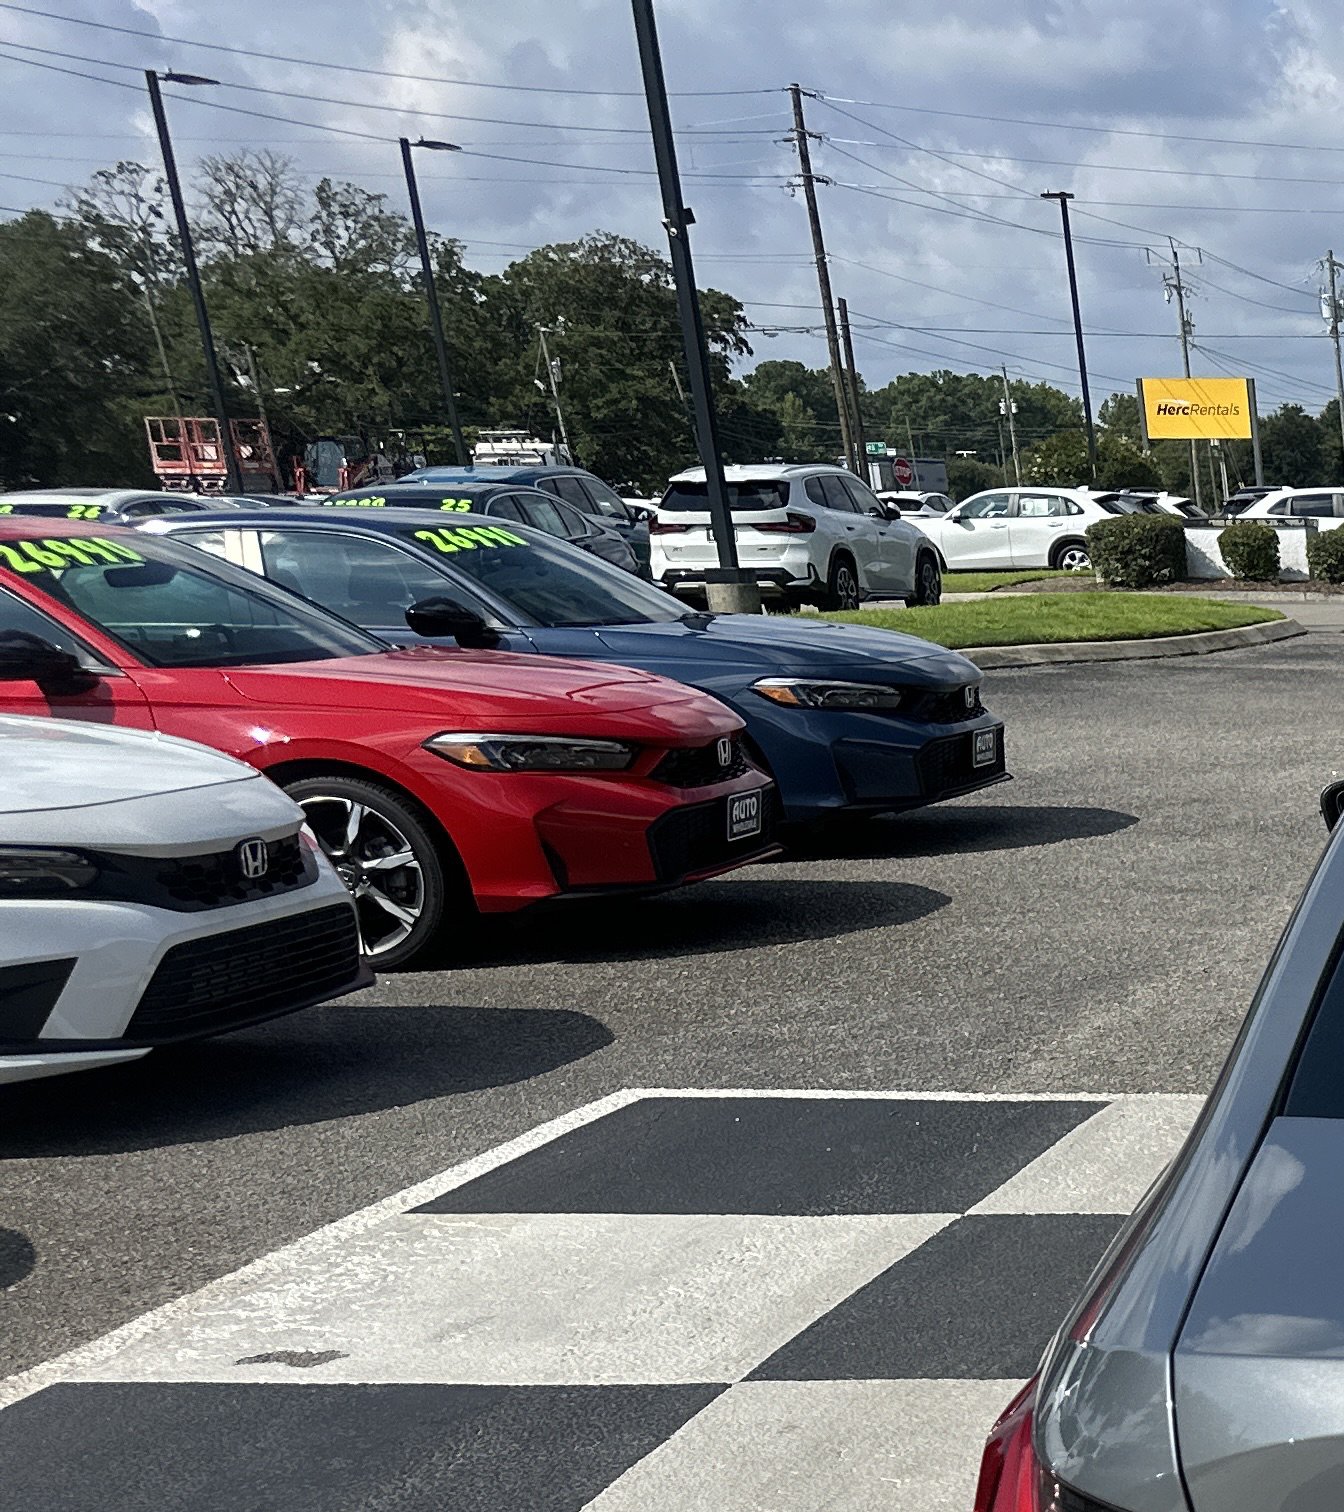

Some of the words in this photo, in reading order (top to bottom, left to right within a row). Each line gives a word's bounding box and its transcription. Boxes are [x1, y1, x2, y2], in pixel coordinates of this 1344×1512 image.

[895, 465, 911, 477] STOP
[67, 505, 102, 519] 26
[440, 498, 473, 513] 25
[415, 526, 531, 553] 26990
[0, 536, 146, 574] 26990
[732, 796, 757, 822] AUTO
